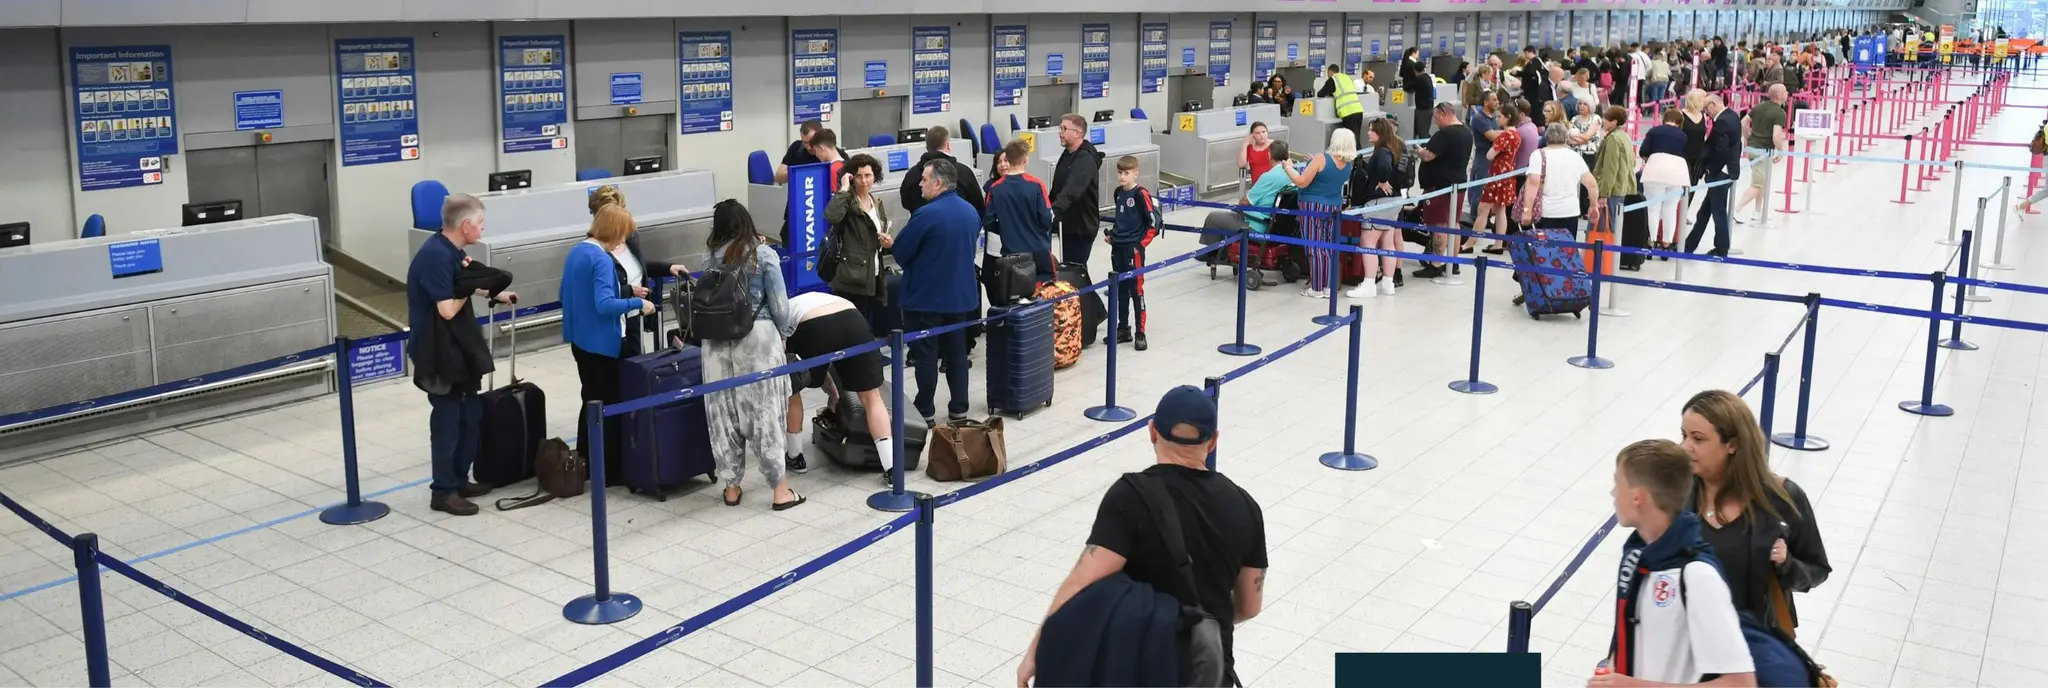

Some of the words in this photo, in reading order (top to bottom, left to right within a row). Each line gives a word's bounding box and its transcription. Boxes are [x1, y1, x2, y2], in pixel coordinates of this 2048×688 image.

[340, 43, 371, 51] Important
[76, 52, 116, 60] Important
[118, 51, 164, 59] Information
[359, 344, 386, 354] NOTICE
